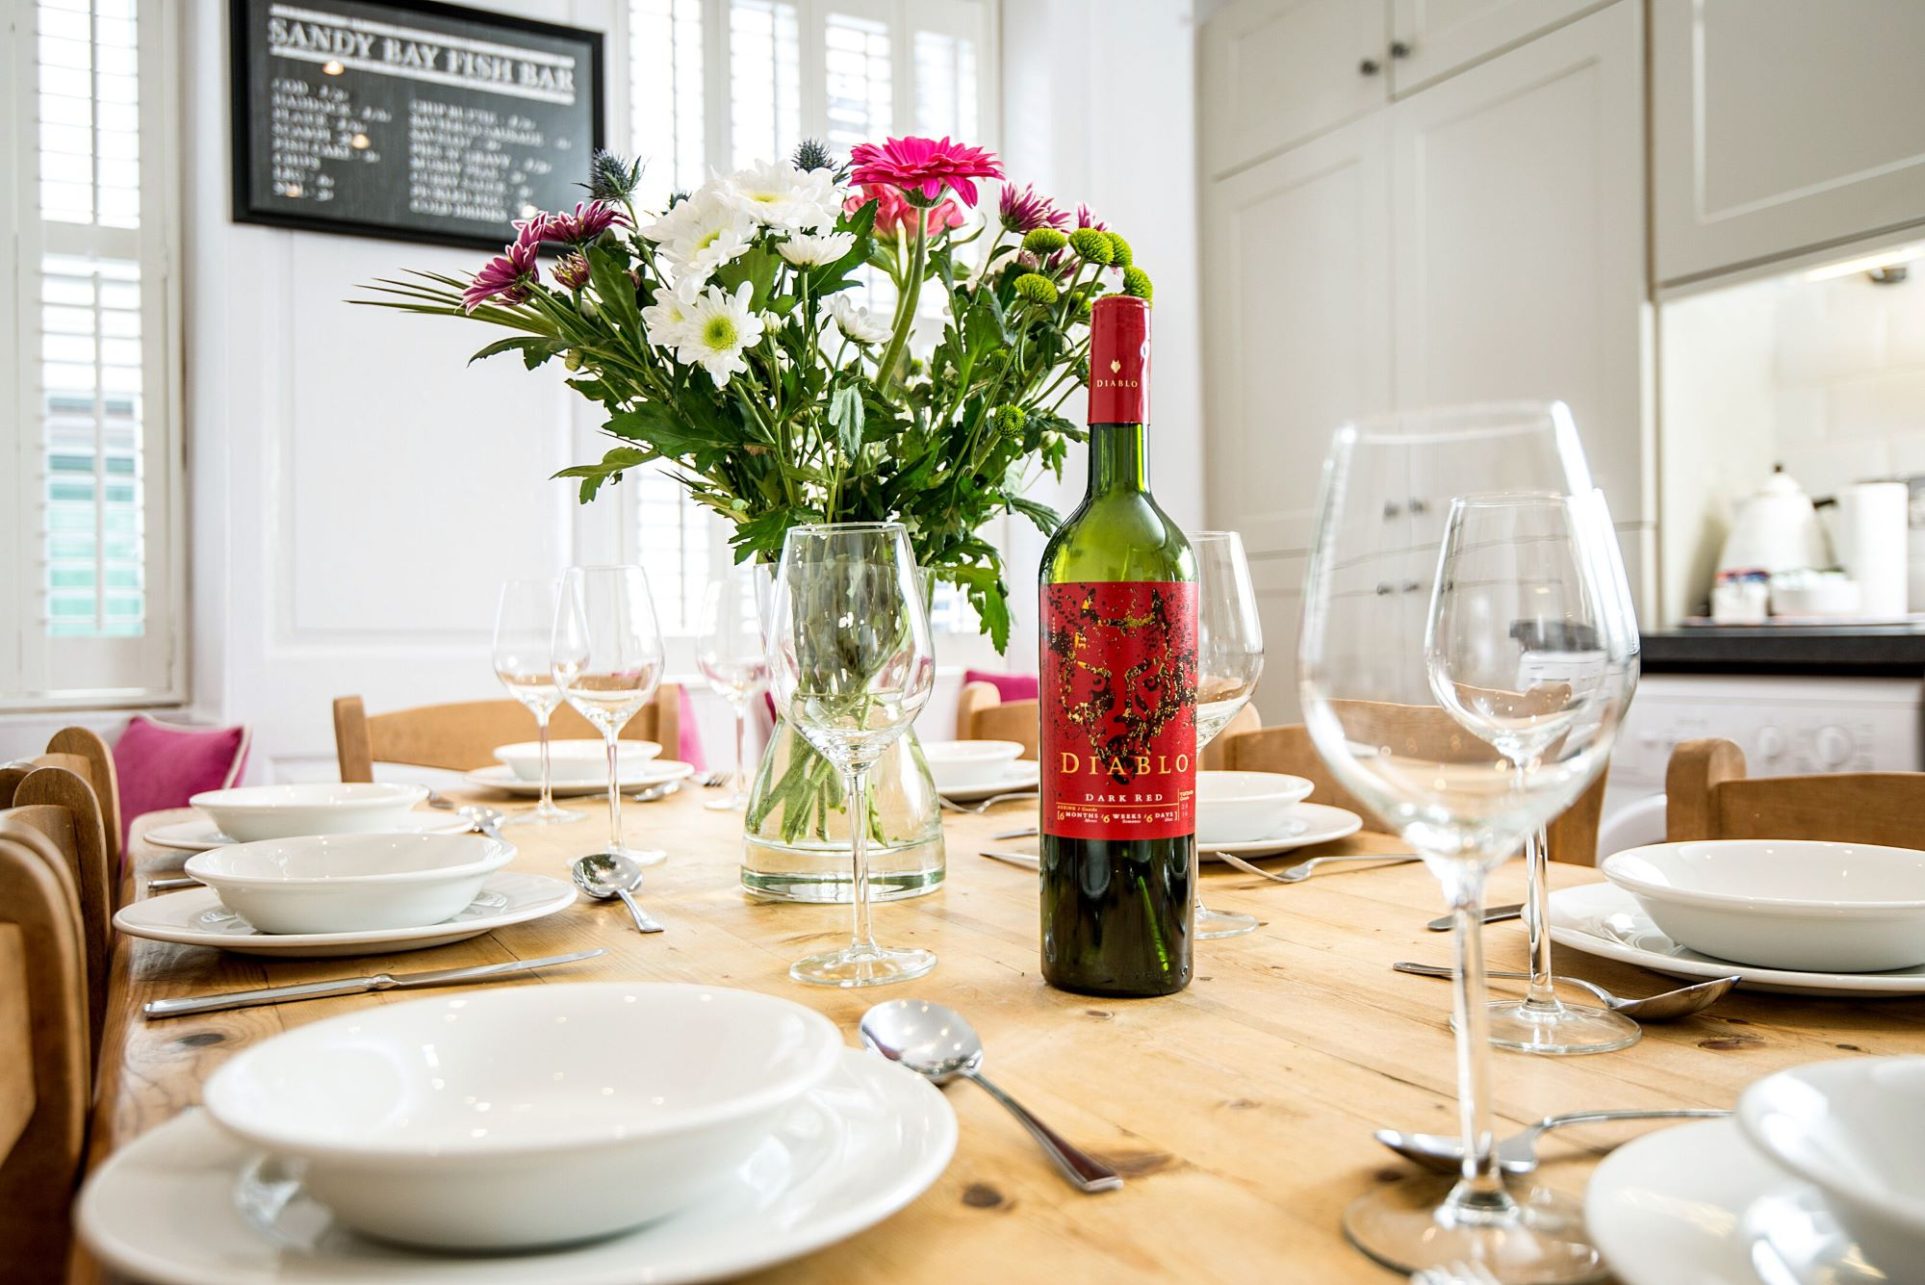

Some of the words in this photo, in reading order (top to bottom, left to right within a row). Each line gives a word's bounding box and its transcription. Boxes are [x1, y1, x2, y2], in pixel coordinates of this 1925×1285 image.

[267, 17, 375, 60] SANDY
[382, 37, 442, 70] BAY
[446, 49, 513, 82] FISH
[518, 62, 575, 92] BAR
[1096, 379, 1138, 388] DIABLO
[1060, 752, 1189, 775] DIABLO
[1085, 793, 1127, 803] DARK
[1135, 794, 1163, 802] RED
[1065, 811, 1099, 819] MONTHS
